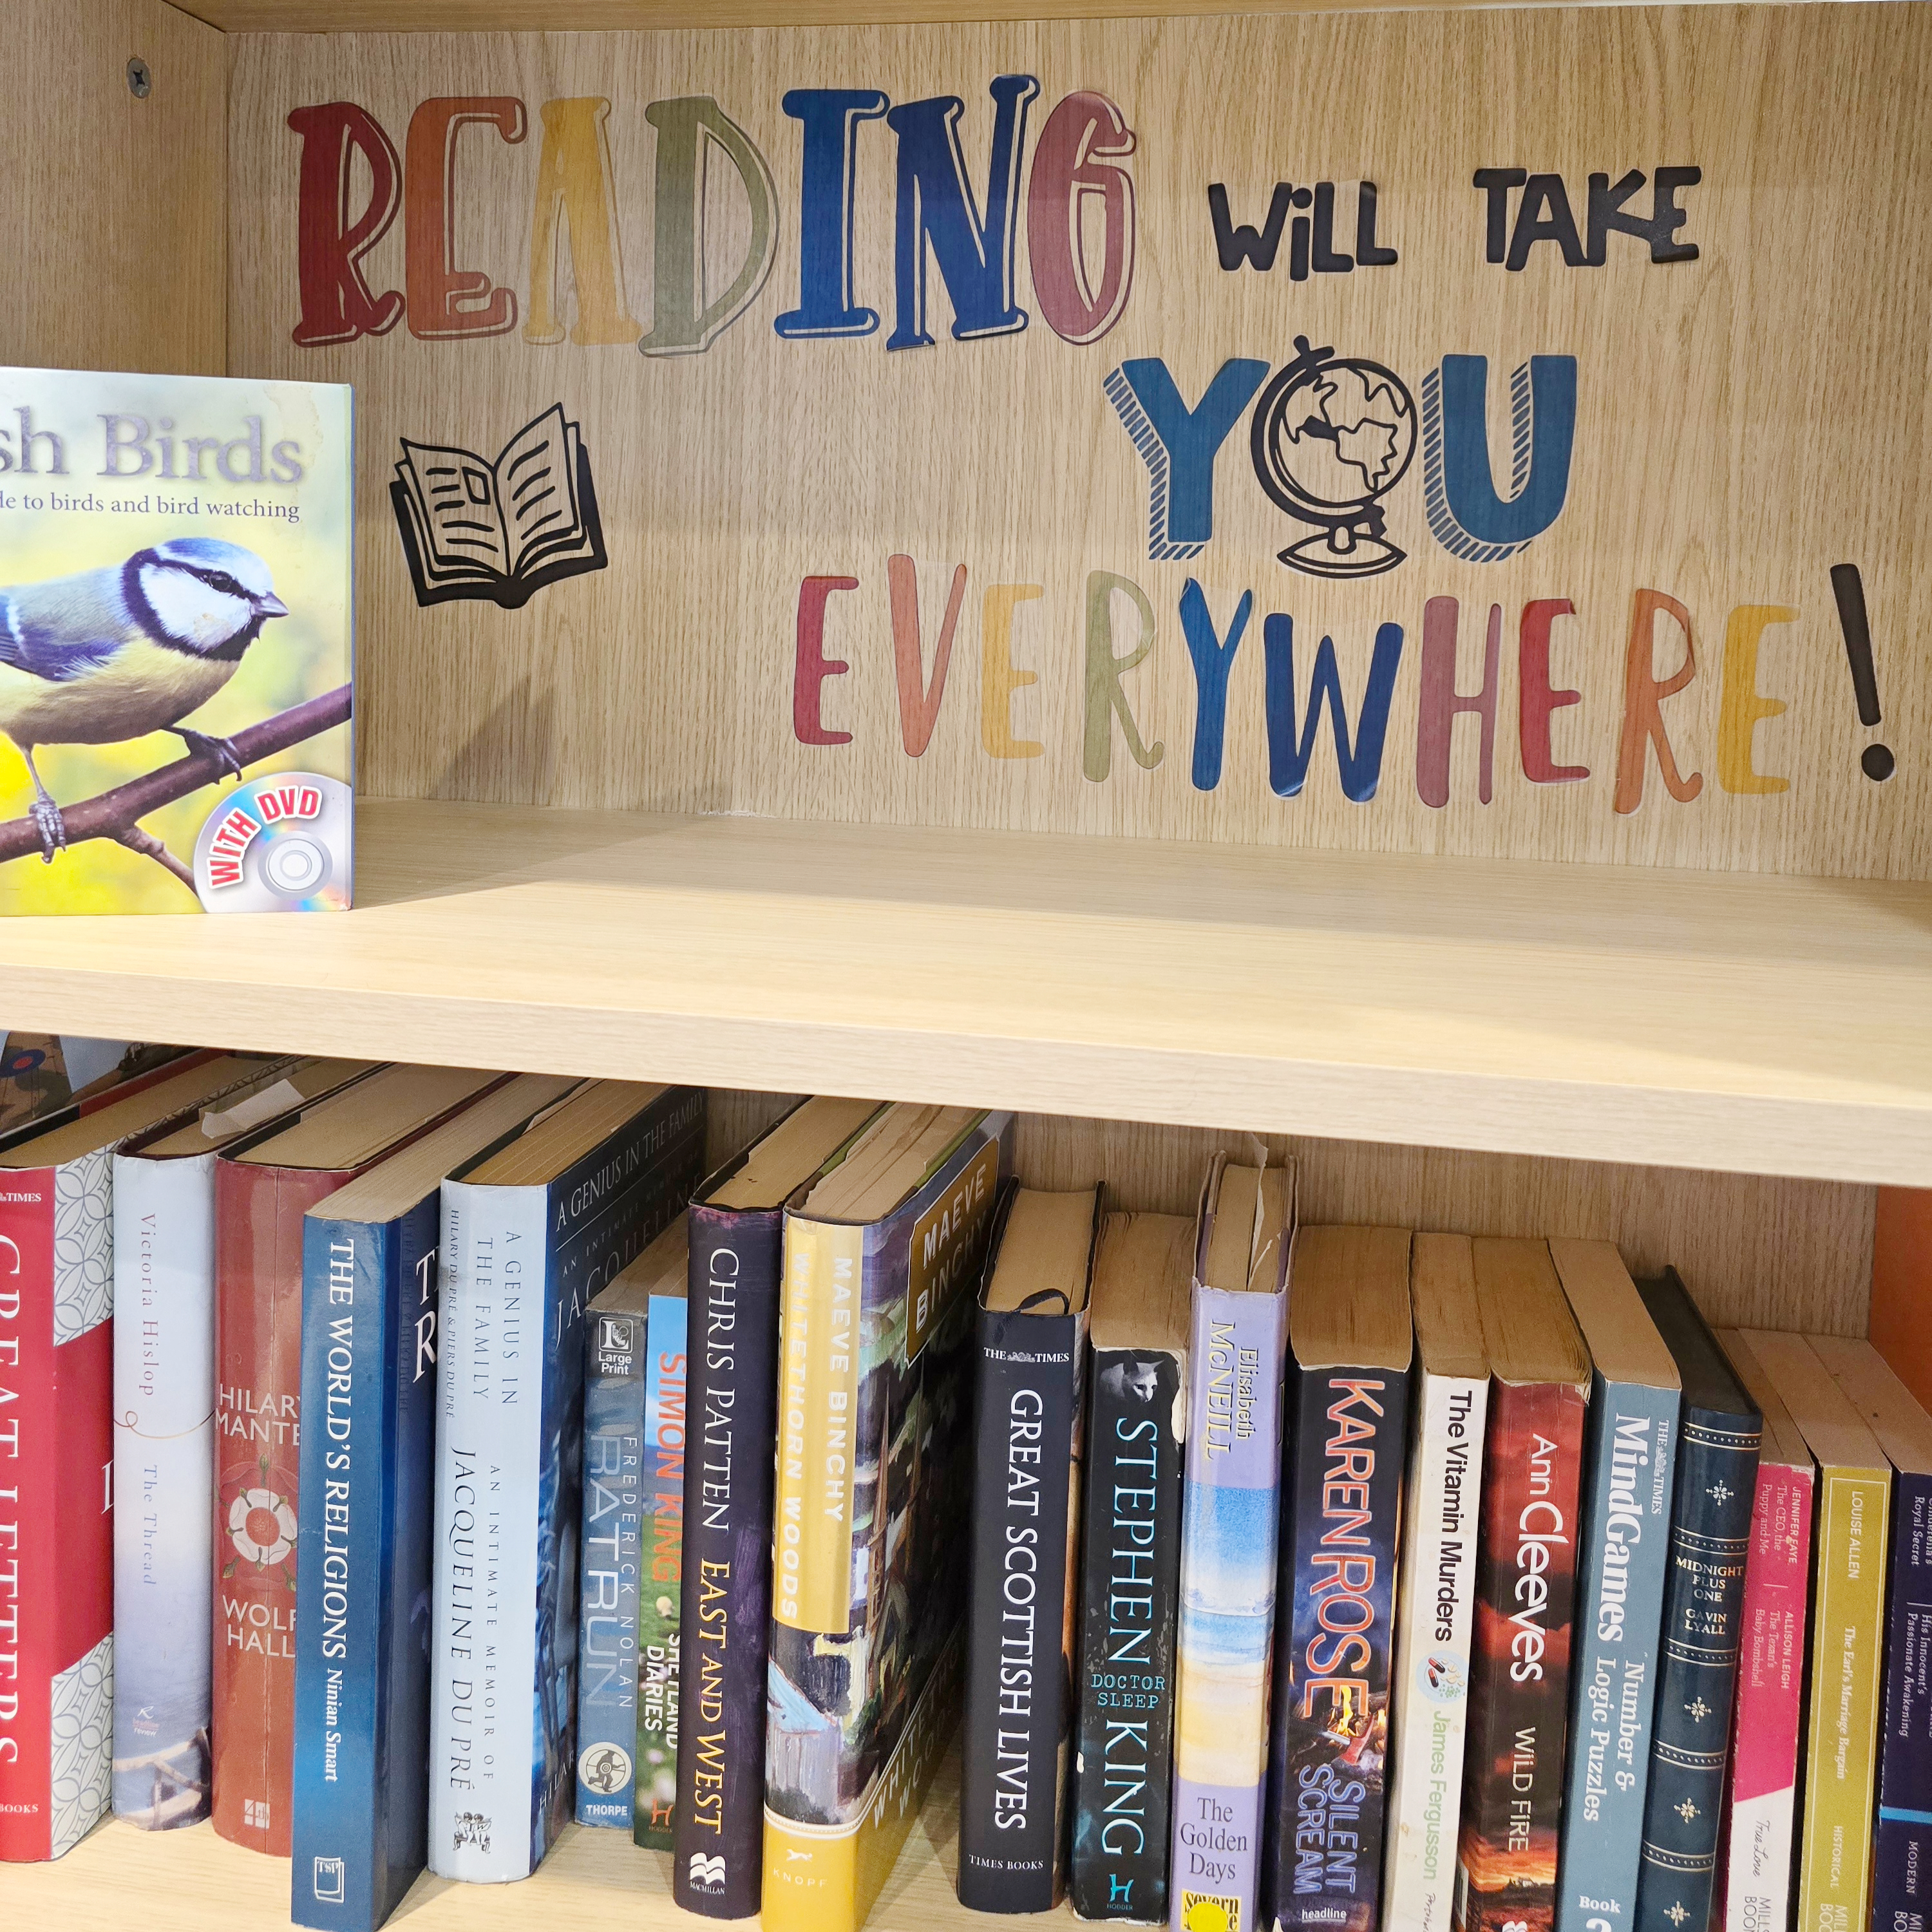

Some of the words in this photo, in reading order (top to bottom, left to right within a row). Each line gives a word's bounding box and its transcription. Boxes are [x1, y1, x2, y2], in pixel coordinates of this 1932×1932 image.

[288, 73, 1137, 357] READING
[1472, 166, 1701, 271] TAKE
[97, 415, 303, 484] Birds
[23, 494, 44, 511] to
[51, 493, 104, 512] birds
[111, 495, 151, 513] and
[156, 495, 200, 516] bird
[206, 500, 300, 524] watching
[796, 553, 1896, 815] EVERYWHERE!
[208, 809, 260, 887] WITH
[256, 787, 320, 822] DVD
[556, 1201, 567, 1233] A
[571, 1155, 621, 1217] GENIUS
[626, 1141, 639, 1176] IN
[643, 1119, 667, 1160] THE
[668, 1088, 705, 1139] FAMILY
[6, 1193, 41, 1202] TIMES
[923, 1163, 986, 1271] MAEVE
[141, 1213, 158, 1306] Victoria
[450, 1209, 459, 1260] HILARY
[477, 1237, 493, 1285] THE
[506, 1231, 522, 1244] A
[330, 1238, 354, 1305] THE
[449, 1264, 458, 1284] DU
[916, 1210, 987, 1334] BINCHY
[447, 1317, 456, 1325] &
[503, 1260, 522, 1358] GENIUS
[706, 1248, 739, 1370] CHRIS
[829, 1257, 853, 1374] MAEVE
[138, 1320, 160, 1396] Hislop
[447, 1330, 457, 1366] PIERS
[473, 1305, 491, 1399] FAMILY
[598, 1351, 632, 1365] Large
[601, 1362, 629, 1375] Print
[786, 1252, 810, 1480] WHITETHORN
[983, 1347, 1007, 1360] THE
[1034, 1353, 1070, 1363] TIMES
[220, 1383, 301, 1419] HILAR
[326, 1314, 354, 1470] WORLD'S
[446, 1371, 455, 1390] DU
[502, 1378, 518, 1404] IN
[1206, 1318, 1236, 1461] McNEILL
[1235, 1347, 1260, 1441] Elisabeth
[656, 1352, 687, 1479] SIMON
[1448, 1390, 1472, 1438] The
[1657, 1420, 1670, 1446] THE
[489, 1465, 501, 1491] AN
[702, 1386, 735, 1531] PATTEN
[825, 1390, 848, 1521] BINCHY
[1007, 1389, 1043, 1516] GREAT
[1320, 1378, 1386, 1546] KAREN
[1530, 1433, 1558, 1495] Ann
[144, 1464, 158, 1503] The
[1441, 1442, 1469, 1533] Vitamin
[1651, 1476, 1665, 1515] TIMES
[1759, 1483, 1772, 1517] Puppy
[1777, 1486, 1787, 1504] The
[621, 1437, 638, 1593] FREDERICK
[652, 1493, 683, 1582] KING
[1596, 1412, 1651, 1642] MindGames
[1761, 1517, 1769, 1535] and
[1790, 1486, 1802, 1536] JENNIFER
[1850, 1490, 1864, 1537] LOUISE
[1912, 1495, 1925, 1527] Royal
[144, 1513, 158, 1584] Thread
[449, 1445, 477, 1660] JACQUELINE
[781, 1497, 802, 1620] WOODS
[1108, 1417, 1158, 1665] STEPHEN
[1676, 1555, 1744, 1577] MIDNIGHT
[1759, 1536, 1769, 1555] Me
[1774, 1533, 1783, 1551] the
[1848, 1540, 1862, 1580] ALLEN
[1911, 1529, 1924, 1566] Secret
[322, 1478, 350, 1659] RELIGIONS
[487, 1512, 500, 1625] INTIMATE
[1435, 1540, 1463, 1642] Murders
[1508, 1501, 1569, 1682] Cleeves
[1692, 1575, 1726, 1589] PLUS
[699, 1557, 731, 1649] EAST
[999, 1526, 1038, 1716] SCOTTISH
[1685, 1608, 1728, 1623] GAVIN
[1694, 1589, 1723, 1602] ONE
[1752, 1609, 1765, 1634] Baby
[1770, 1610, 1780, 1629] The
[228, 1623, 296, 1658] HALL
[1303, 1553, 1377, 1719] ROSE
[1684, 1619, 1725, 1634] LYALL
[1782, 1611, 1794, 1656] ALLISON
[1844, 1626, 1856, 1649] The
[1904, 1612, 1918, 1672] Passionate
[1920, 1614, 1932, 1633] His
[619, 1616, 634, 1707] NOLAN
[1091, 1674, 1165, 1691] DOCTOR
[1751, 1634, 1764, 1687] Bombshell
[1781, 1657, 1791, 1689] LEIGH
[1841, 1650, 1855, 1683] Earl's
[1917, 1636, 1931, 1695] Innocent's
[325, 1667, 343, 1727] Ninian
[451, 1678, 473, 1725] DU
[484, 1645, 497, 1736] MEMOIR
[645, 1645, 665, 1732] DIARIES
[700, 1652, 723, 1723] AND
[1097, 1693, 1159, 1709] SLEEP
[1587, 1656, 1616, 1725] Logic
[1615, 1660, 1645, 1761] Number
[1835, 1684, 1853, 1737] Marriage
[1898, 1675, 1915, 1738] Awakening
[324, 1730, 341, 1783] Smart
[450, 1736, 475, 1790] PRÉ
[484, 1755, 495, 1779] OF
[1430, 1710, 1451, 1775] James
[1833, 1738, 1848, 1780] Bargain
[694, 1729, 726, 1835] WEST
[995, 1728, 1030, 1830] LIVES
[1101, 1719, 1149, 1855] KING
[1584, 1730, 1611, 1823] Puzzles
[1615, 1771, 1636, 1792] &
[586, 1804, 627, 1816] THORPE
[1197, 1797, 1233, 1823] The
[1293, 1765, 1334, 1895] SCREAM
[1423, 1779, 1447, 1880] Fergusson
[1757, 1820, 1770, 1848] True
[969, 1854, 1003, 1869] TIMES
[1007, 1860, 1044, 1870] BOOKS
[1180, 1823, 1248, 1853] Golden
[1325, 1781, 1365, 1894] SILENT
[1752, 1850, 1769, 1877] Love
[1829, 1824, 1842, 1888] HISTORICAL
[690, 1881, 726, 1895] MACMILLAN
[773, 1868, 828, 1887] KNOPF
[1189, 1852, 1236, 1884] Days
[1904, 1840, 1920, 1895] MODERN
[1302, 1907, 1347, 1920] headline
[1579, 1895, 1621, 1914] Book
